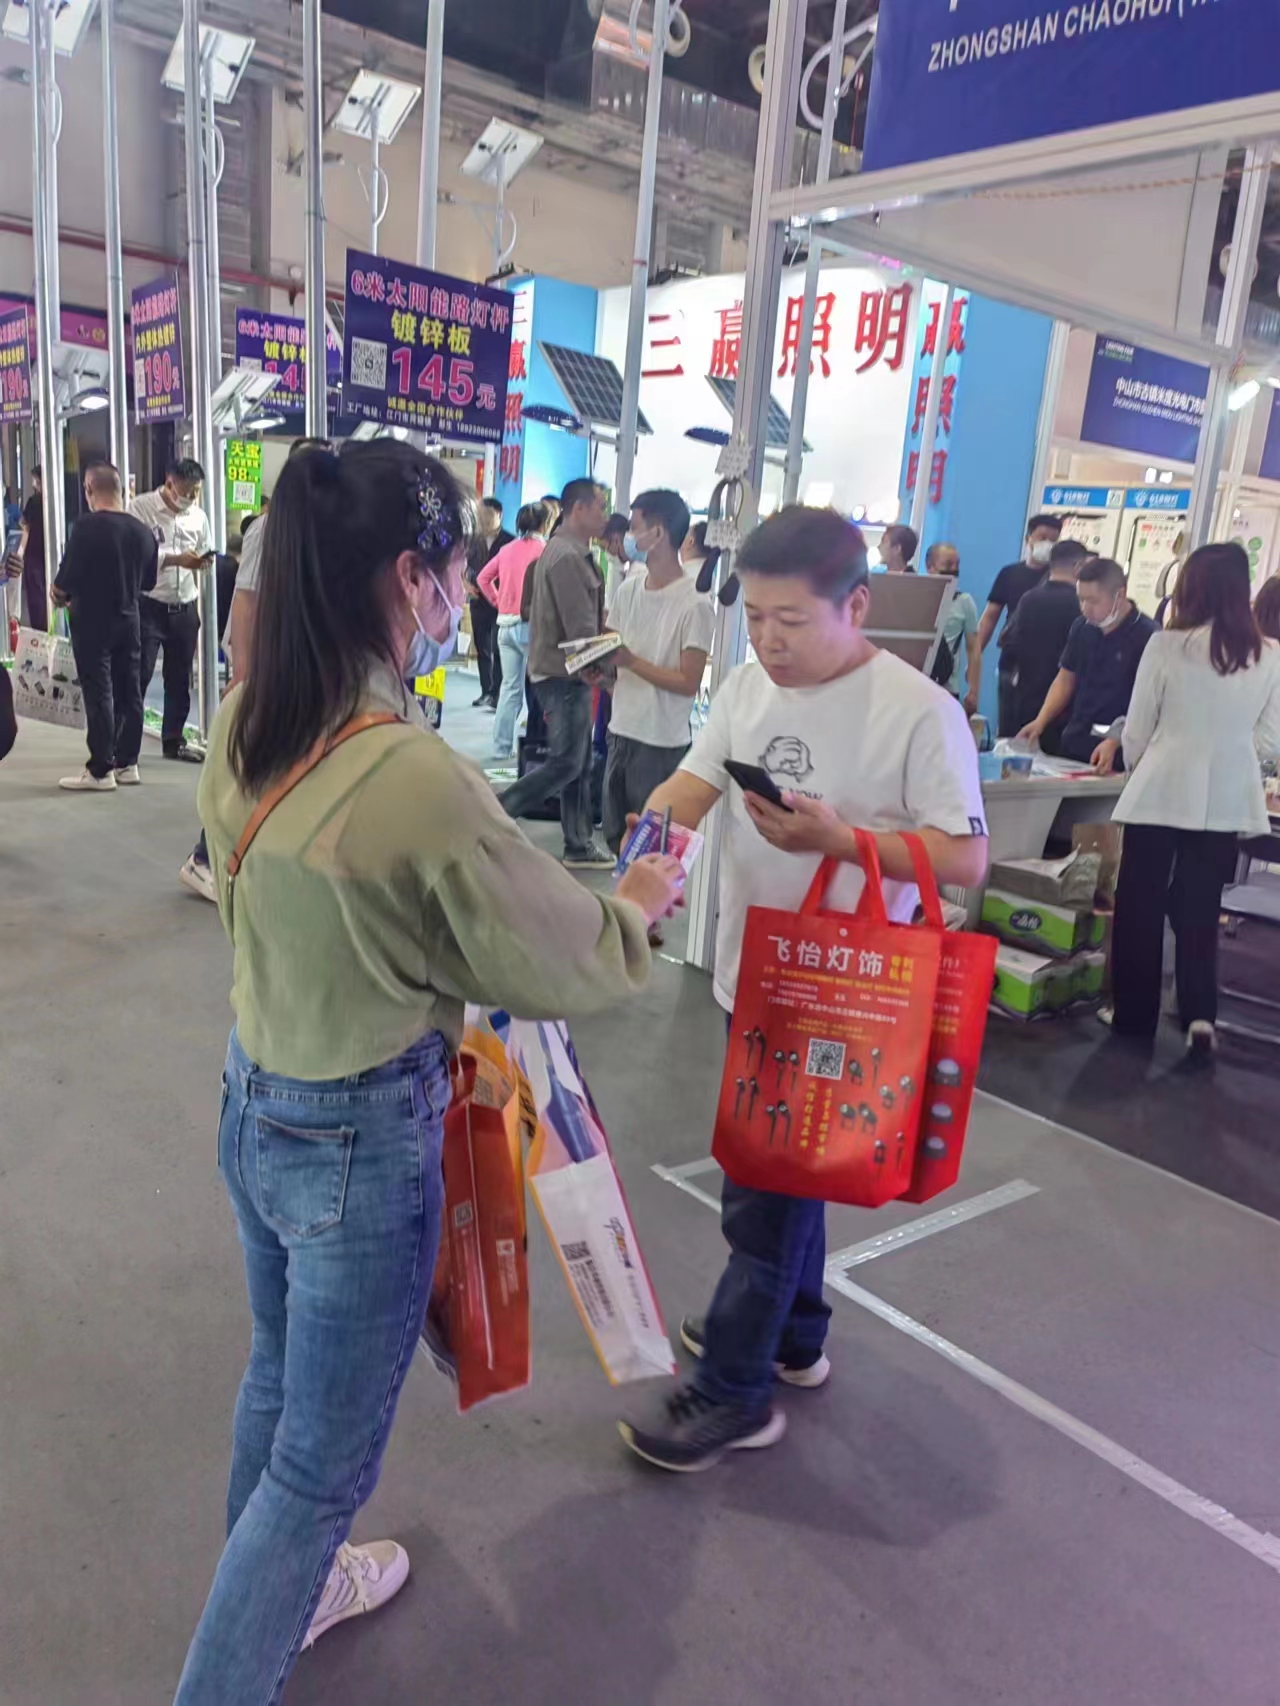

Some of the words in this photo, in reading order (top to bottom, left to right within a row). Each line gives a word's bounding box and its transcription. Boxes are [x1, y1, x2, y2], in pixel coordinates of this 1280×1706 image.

[927, 11, 1060, 73] ZHONGSHAN
[350, 269, 509, 334] 6米太阳能路灯杆
[391, 309, 472, 357] 镀锌板
[392, 346, 497, 410] 145元
[228, 465, 248, 481] 98
[767, 935, 884, 978] 飞怡灯饰
